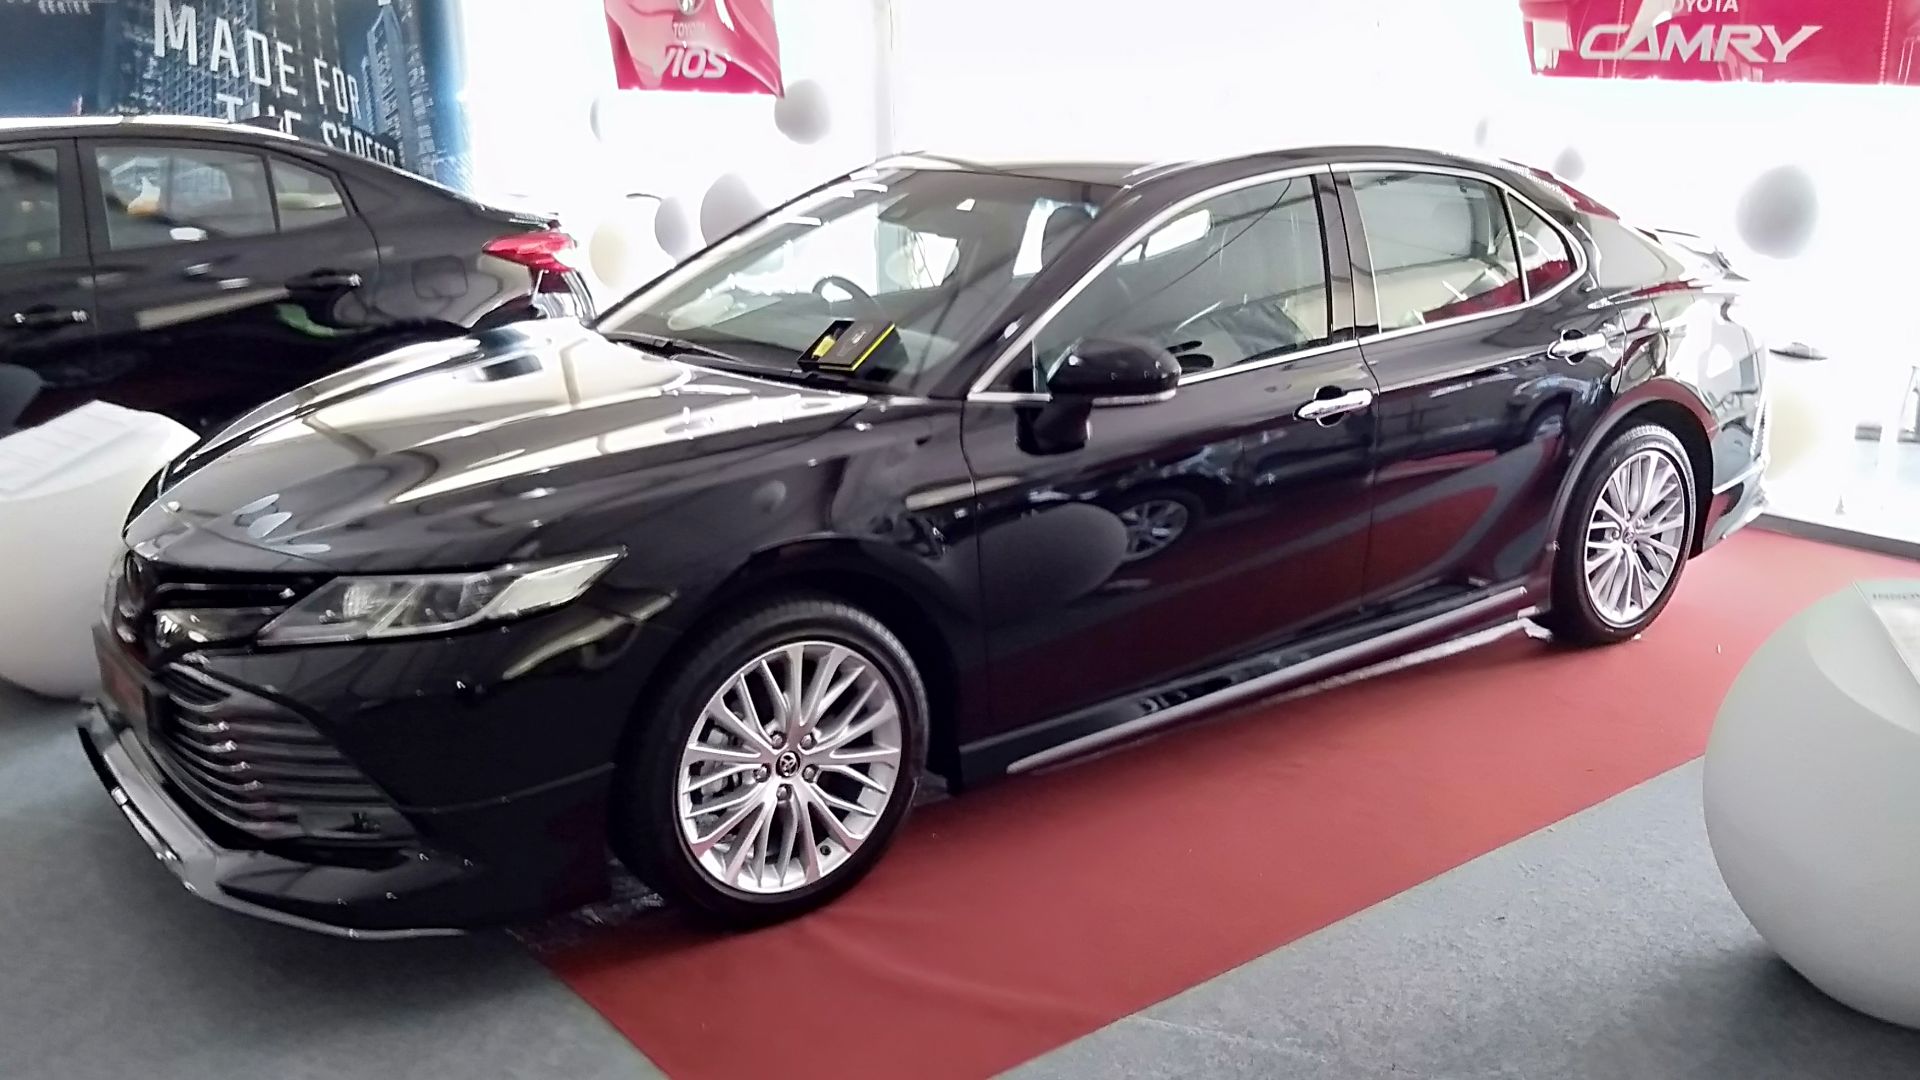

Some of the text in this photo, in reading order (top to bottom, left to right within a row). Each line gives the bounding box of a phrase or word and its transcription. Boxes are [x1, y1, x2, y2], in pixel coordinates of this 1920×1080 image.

[154, 0, 361, 120] MADE FOR
[651, 46, 728, 79] VIOS
[1580, 23, 1823, 63] CAMRY
